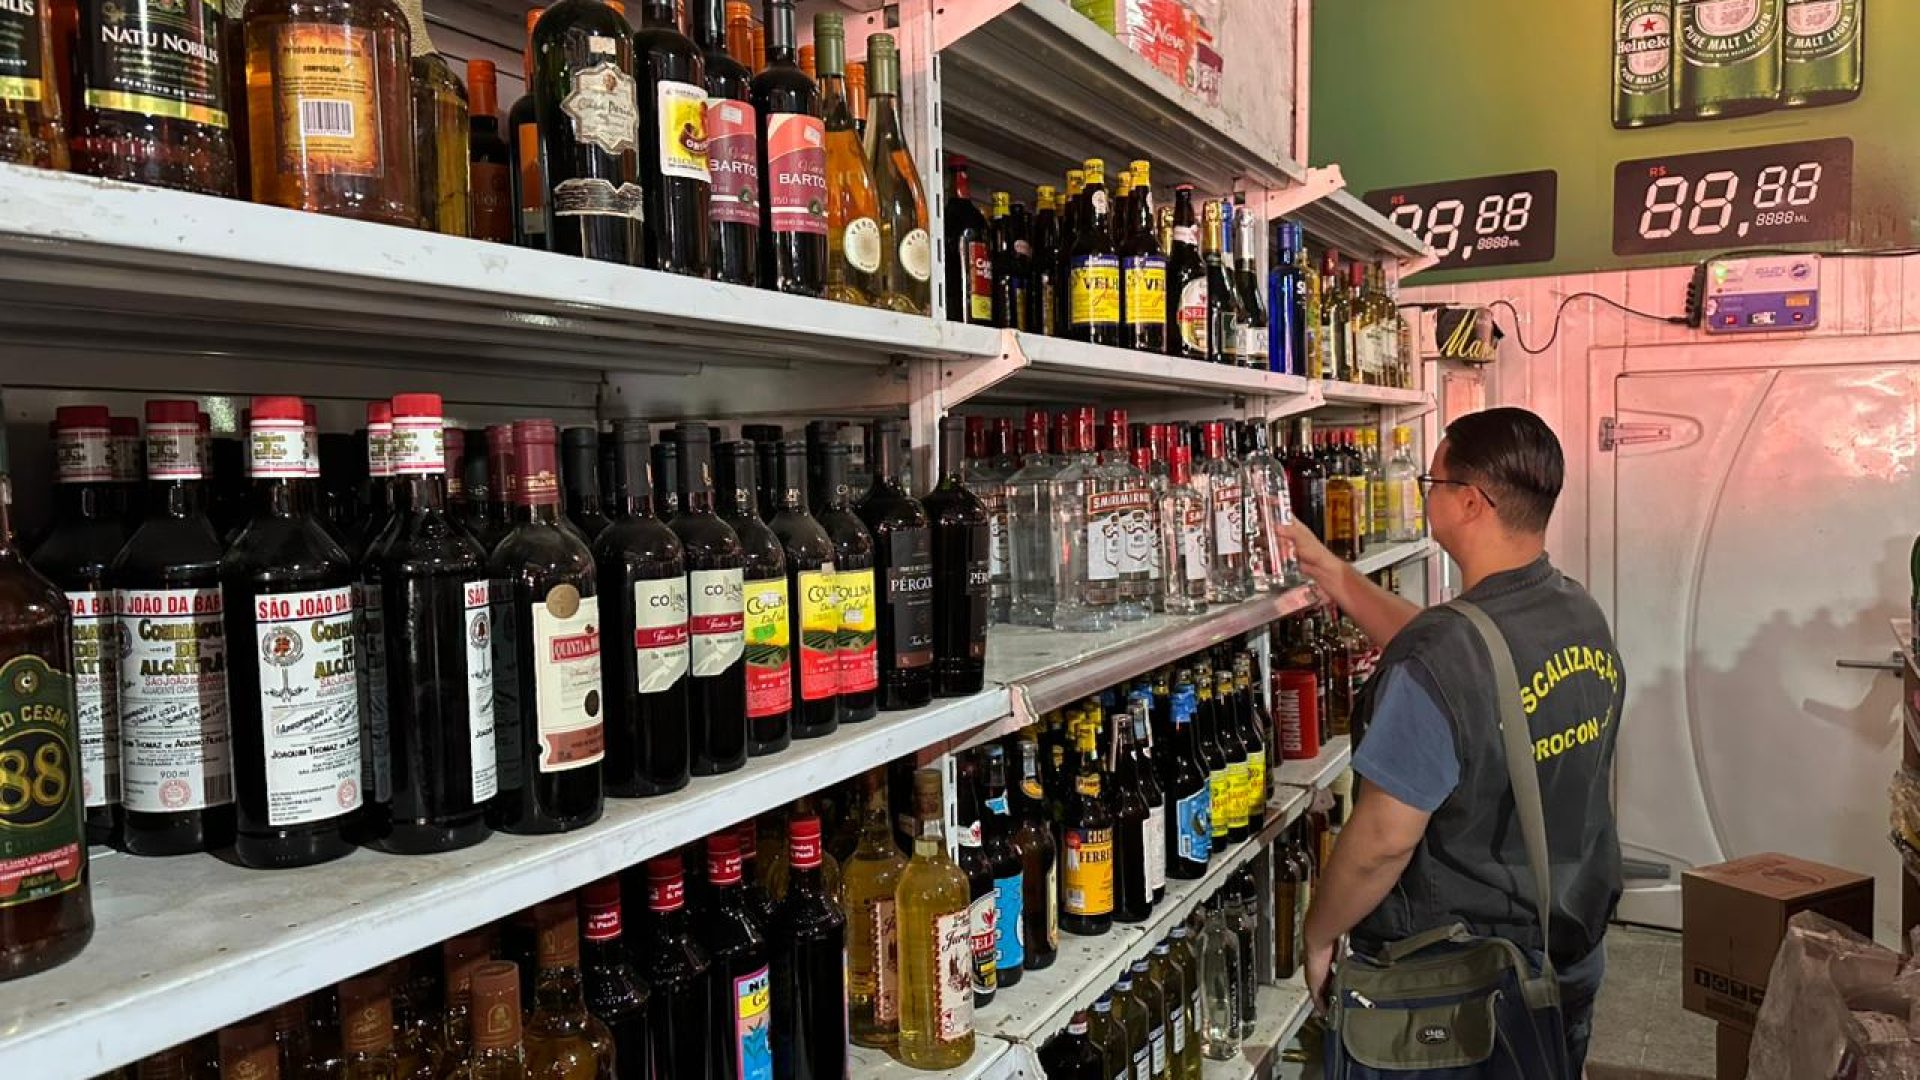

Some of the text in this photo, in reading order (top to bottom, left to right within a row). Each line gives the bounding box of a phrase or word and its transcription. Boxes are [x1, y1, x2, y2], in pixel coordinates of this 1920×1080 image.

[1684, 12, 1773, 50] PURE MALT LAGER
[1793, 36, 1824, 49] MALT
[101, 24, 220, 65] NATU NOBILIS
[1649, 165, 1666, 176] R$
[1753, 162, 1822, 208] 88
[1475, 191, 1532, 235] 88
[1755, 211, 1795, 227] 8888
[127, 593, 162, 614] JOÃO
[167, 596, 189, 613] DA
[259, 597, 289, 619] SÃO
[297, 594, 332, 617] JOÃO
[21, 704, 69, 729] CESAR
[1530, 717, 1599, 762] ROCON
[0, 742, 67, 815] 88
[160, 769, 190, 779] 900 ml
